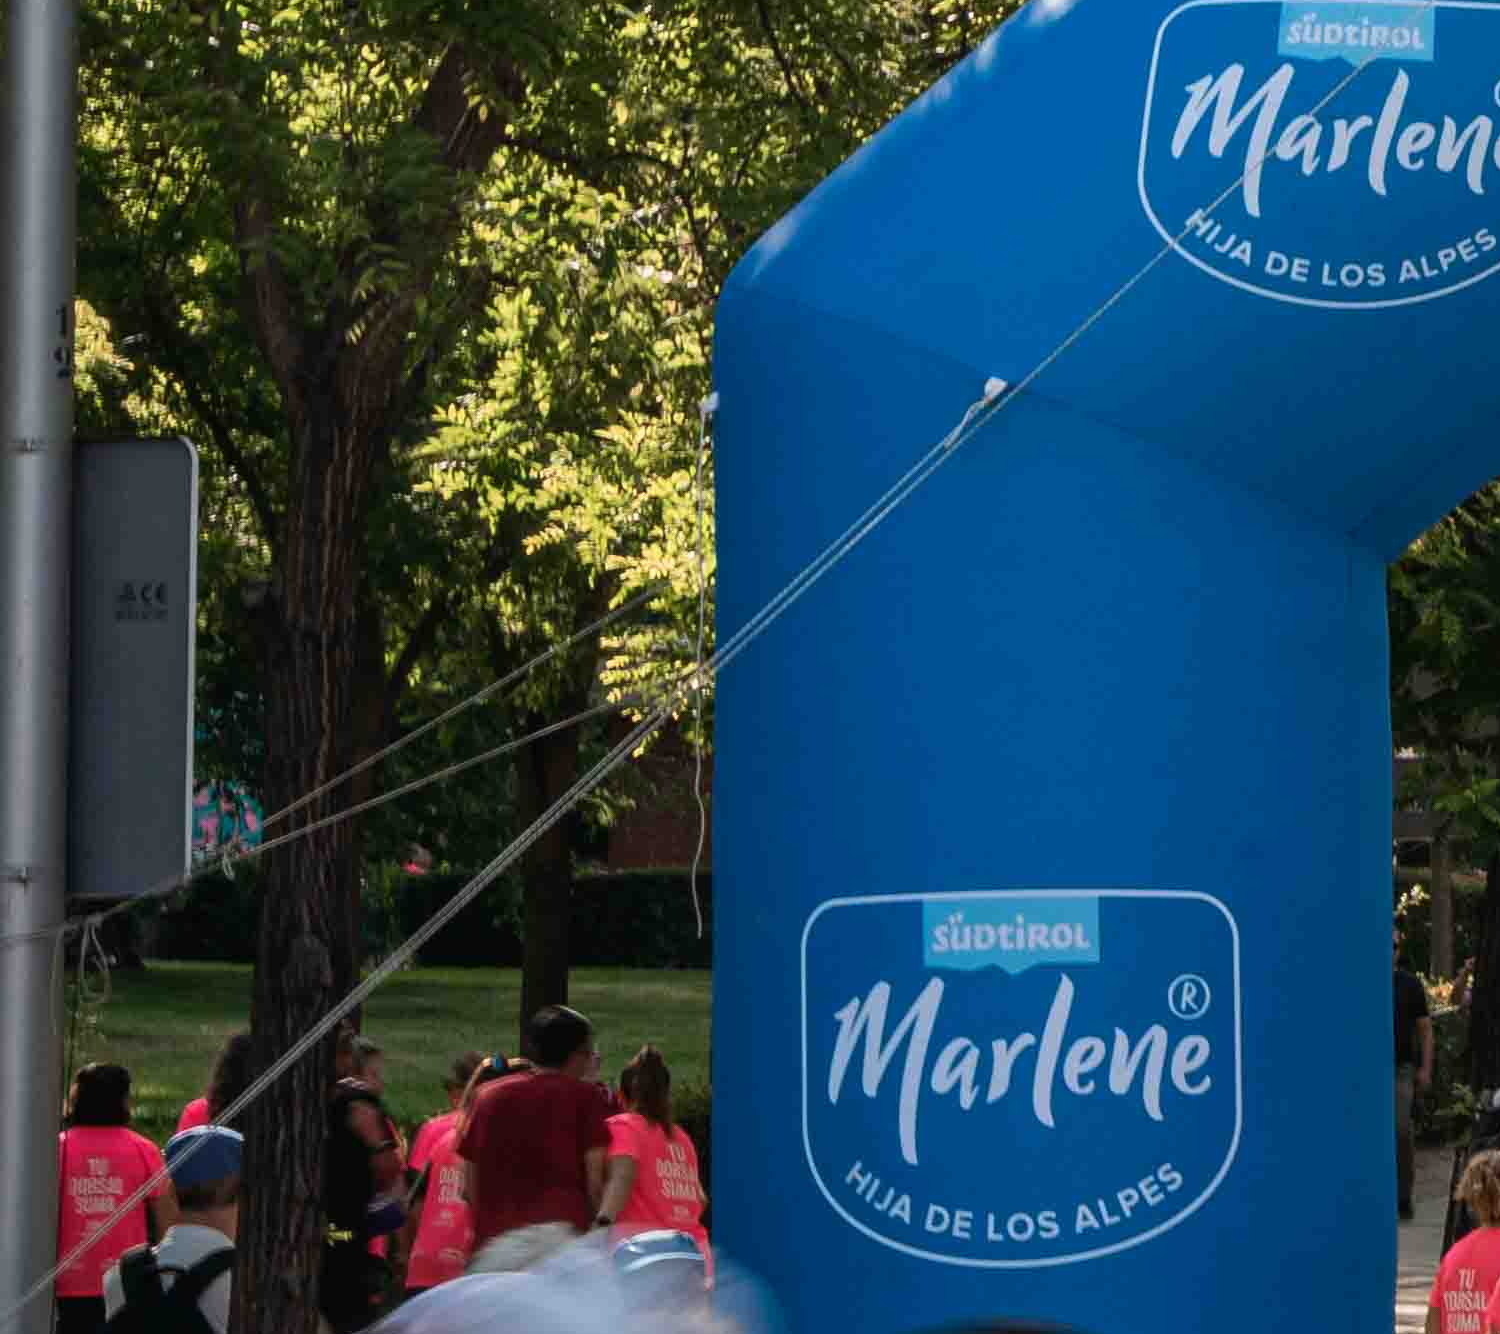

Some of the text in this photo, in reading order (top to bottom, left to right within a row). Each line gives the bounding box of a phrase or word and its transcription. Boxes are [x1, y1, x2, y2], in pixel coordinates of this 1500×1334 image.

[1185, 208, 1497, 287] HIJA DE LOS ALPES
[845, 1161, 1183, 1242] HIJA DE LOS ALPES
[1457, 1267, 1476, 1289] TU
